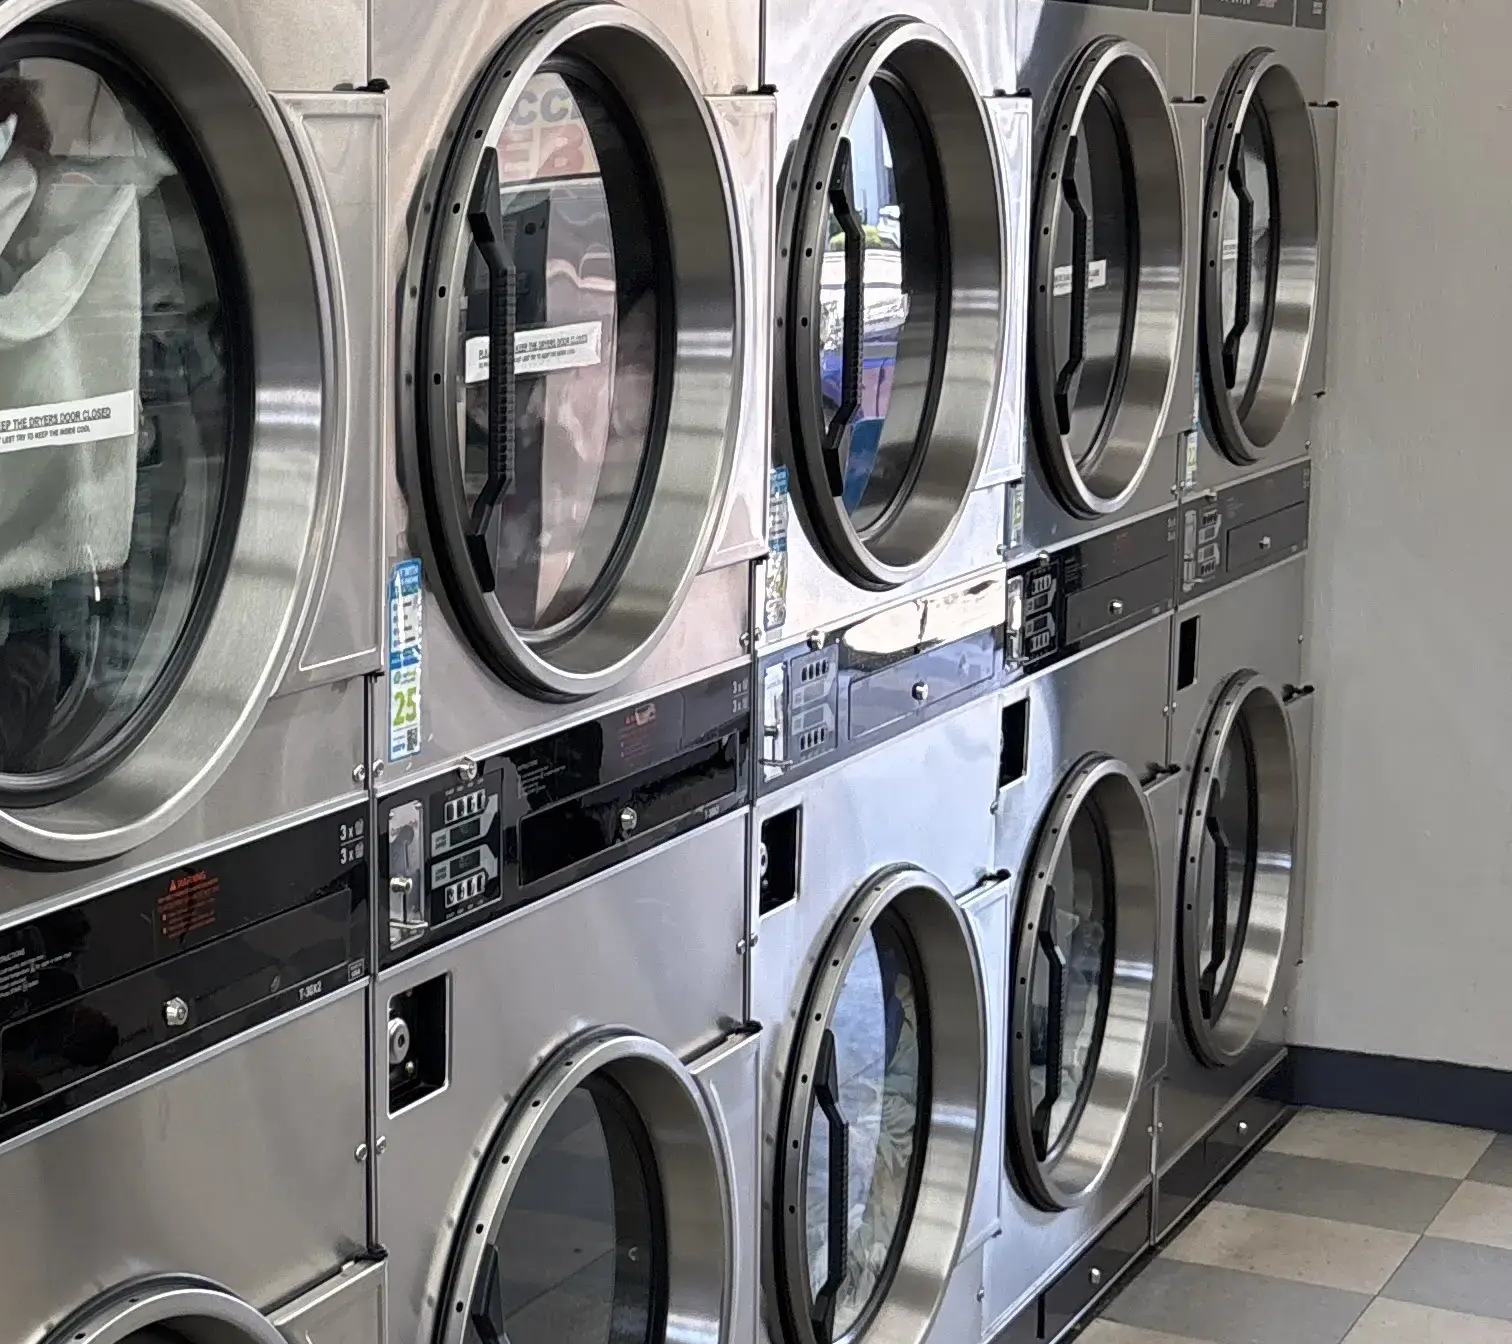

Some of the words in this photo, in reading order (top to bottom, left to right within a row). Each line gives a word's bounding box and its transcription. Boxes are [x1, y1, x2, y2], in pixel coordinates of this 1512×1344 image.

[392, 686, 418, 728] 25
[340, 824, 347, 841] 3
[340, 847, 347, 864] 3
